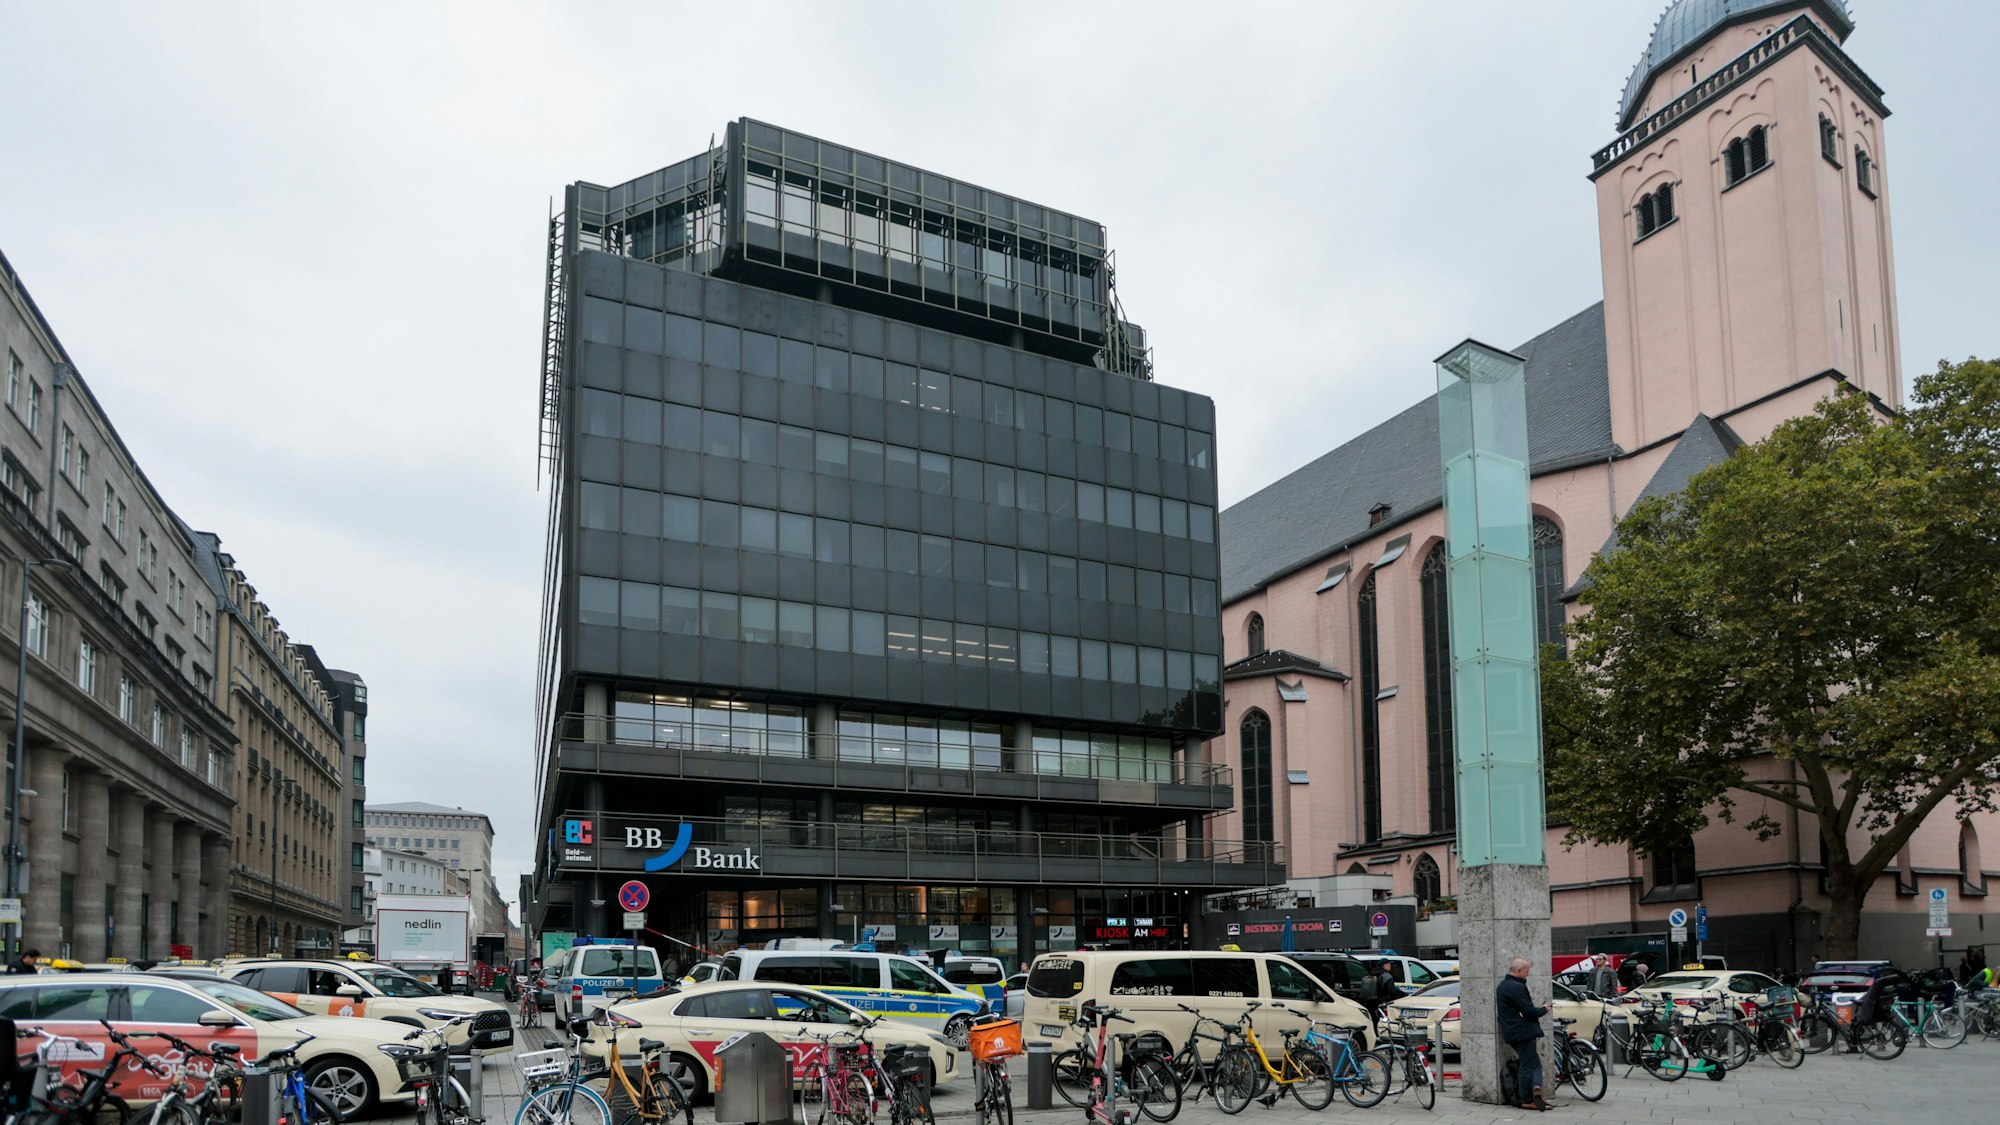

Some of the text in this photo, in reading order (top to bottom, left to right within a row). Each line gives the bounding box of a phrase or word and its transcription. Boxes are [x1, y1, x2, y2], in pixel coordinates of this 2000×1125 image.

[624, 827, 663, 849] BB
[694, 847, 761, 870] Bank
[404, 919, 442, 930] nedlin
[1244, 923, 1278, 934] BISTRO
[1298, 922, 1325, 932] DOM
[1095, 927, 1168, 938] KIOSK AM HBF
[582, 979, 615, 987] POLIZEI
[843, 999, 875, 1010] LIZEI
